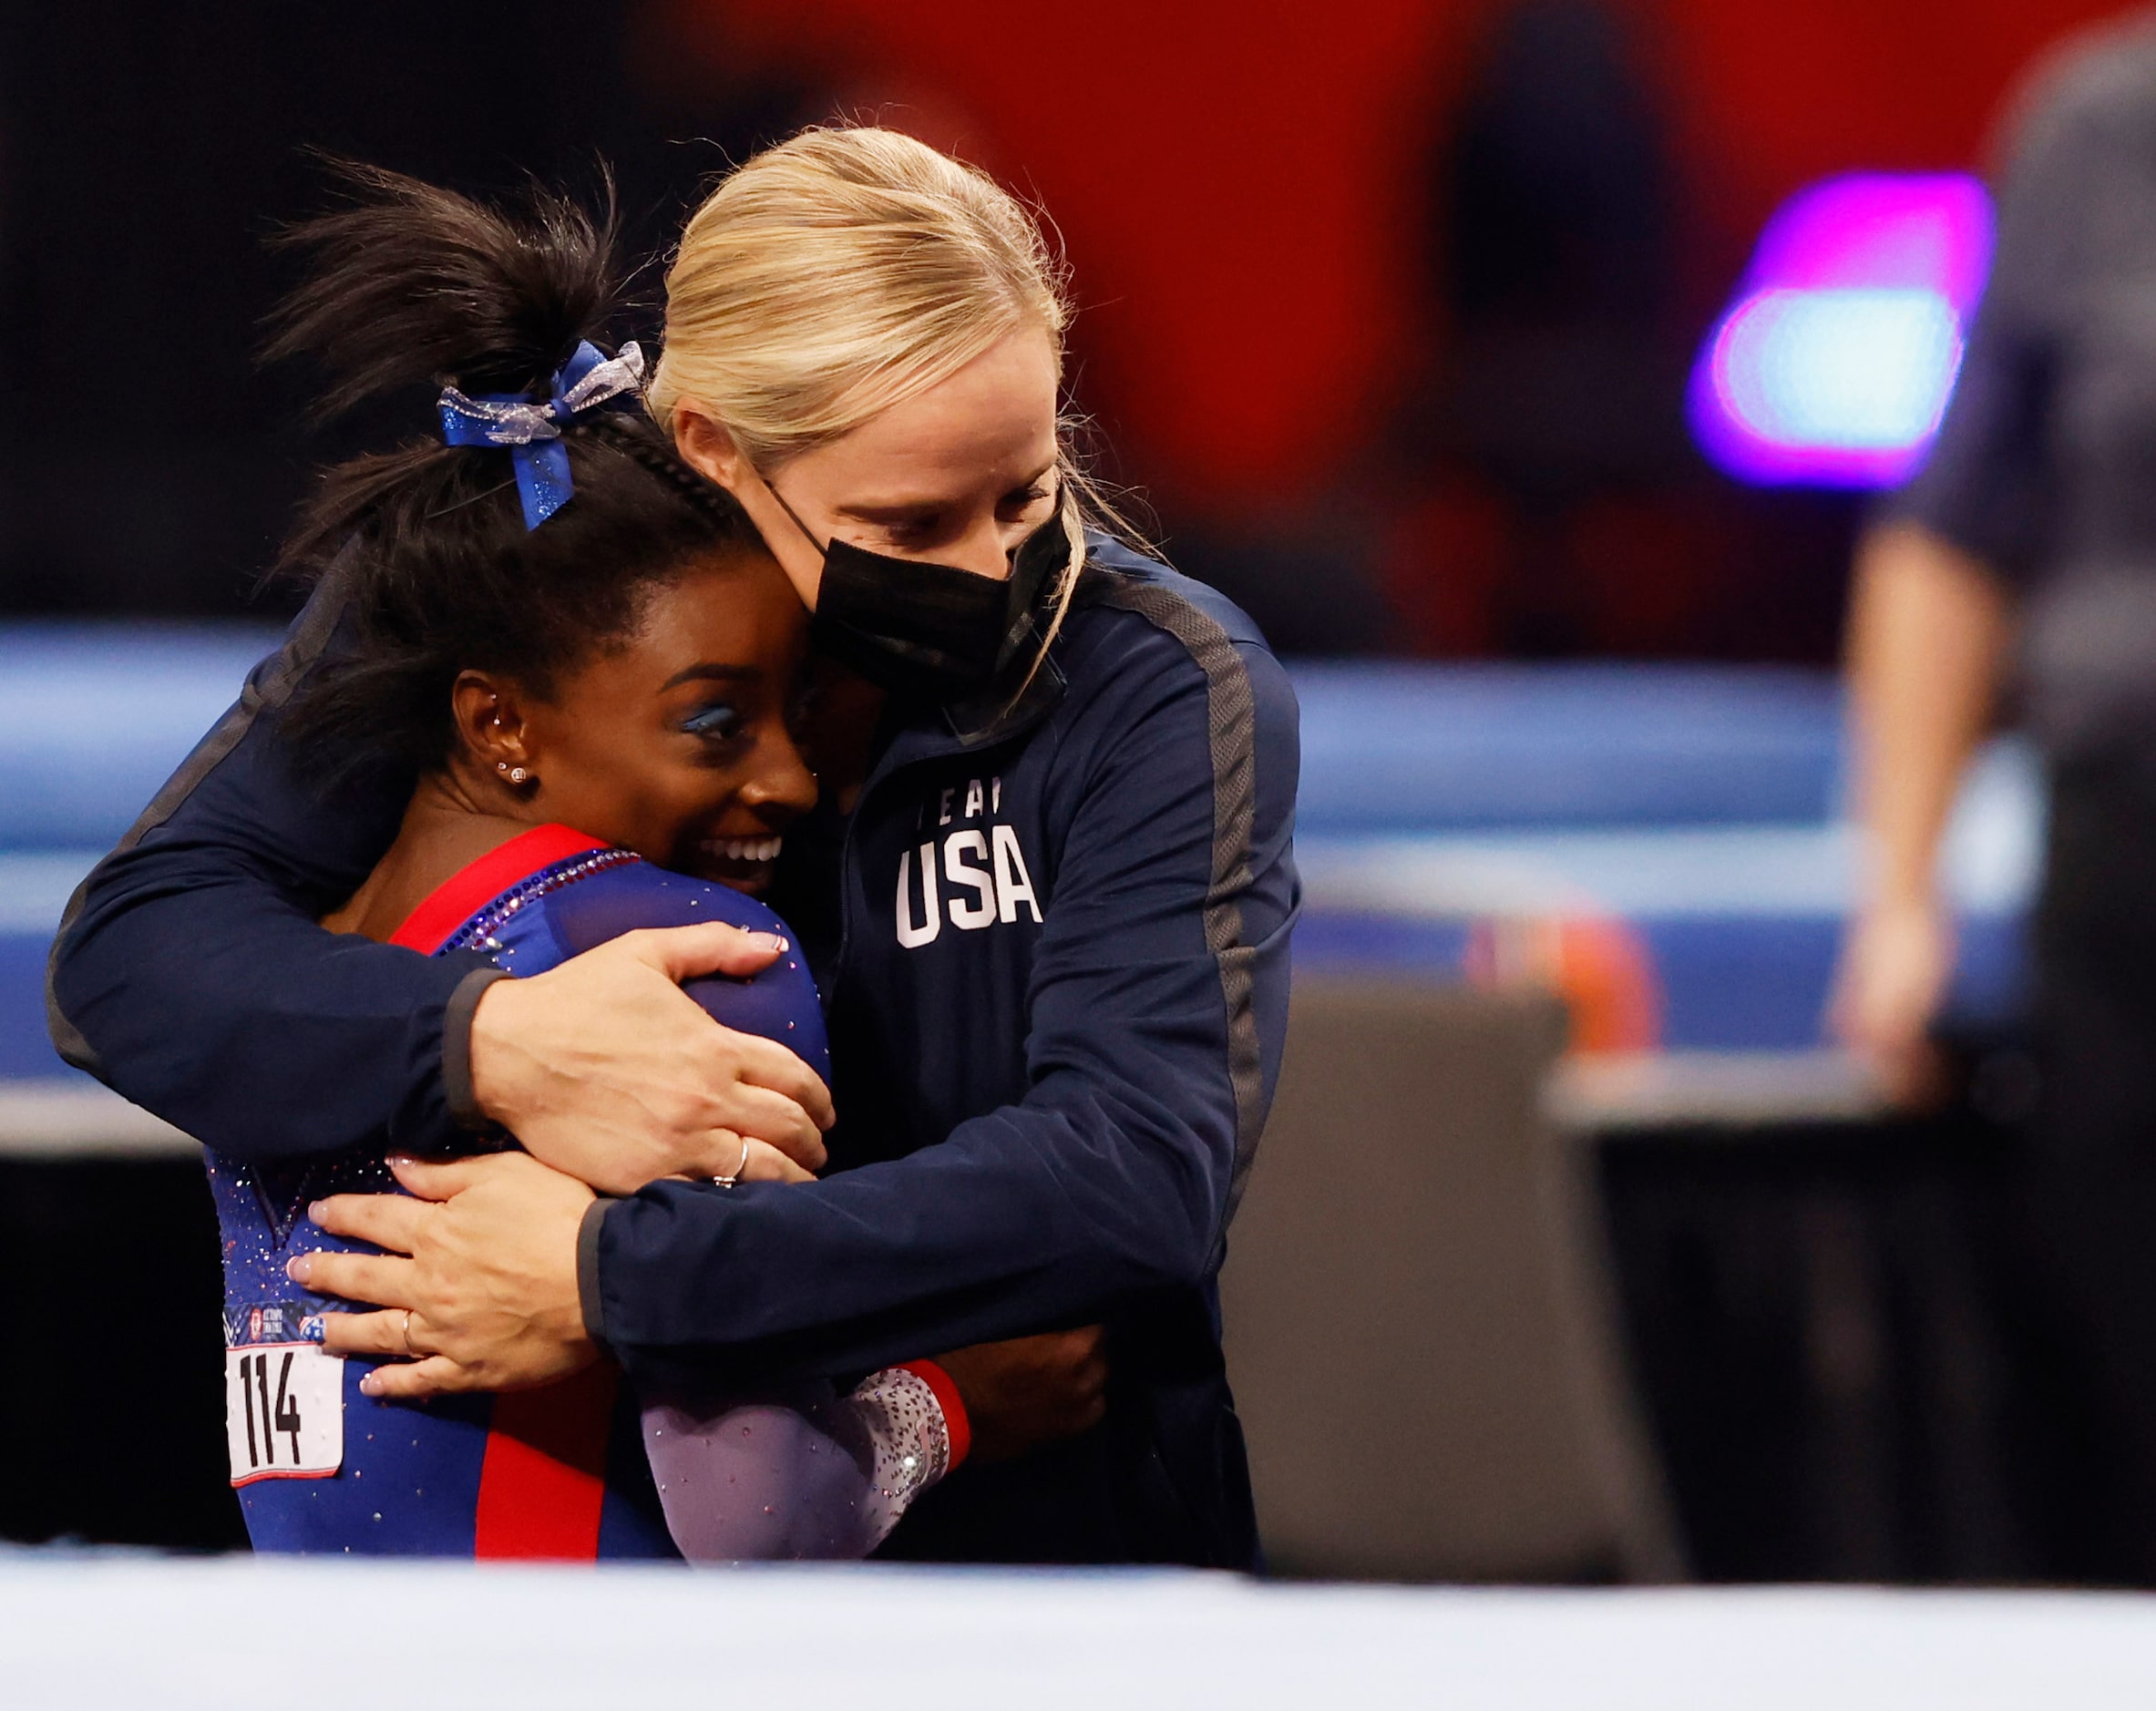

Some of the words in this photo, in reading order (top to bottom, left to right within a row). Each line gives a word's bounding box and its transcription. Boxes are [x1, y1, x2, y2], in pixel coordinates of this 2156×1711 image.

[916, 776, 1001, 832] EA
[896, 825, 1043, 948] USA
[240, 1352, 301, 1468] 114
